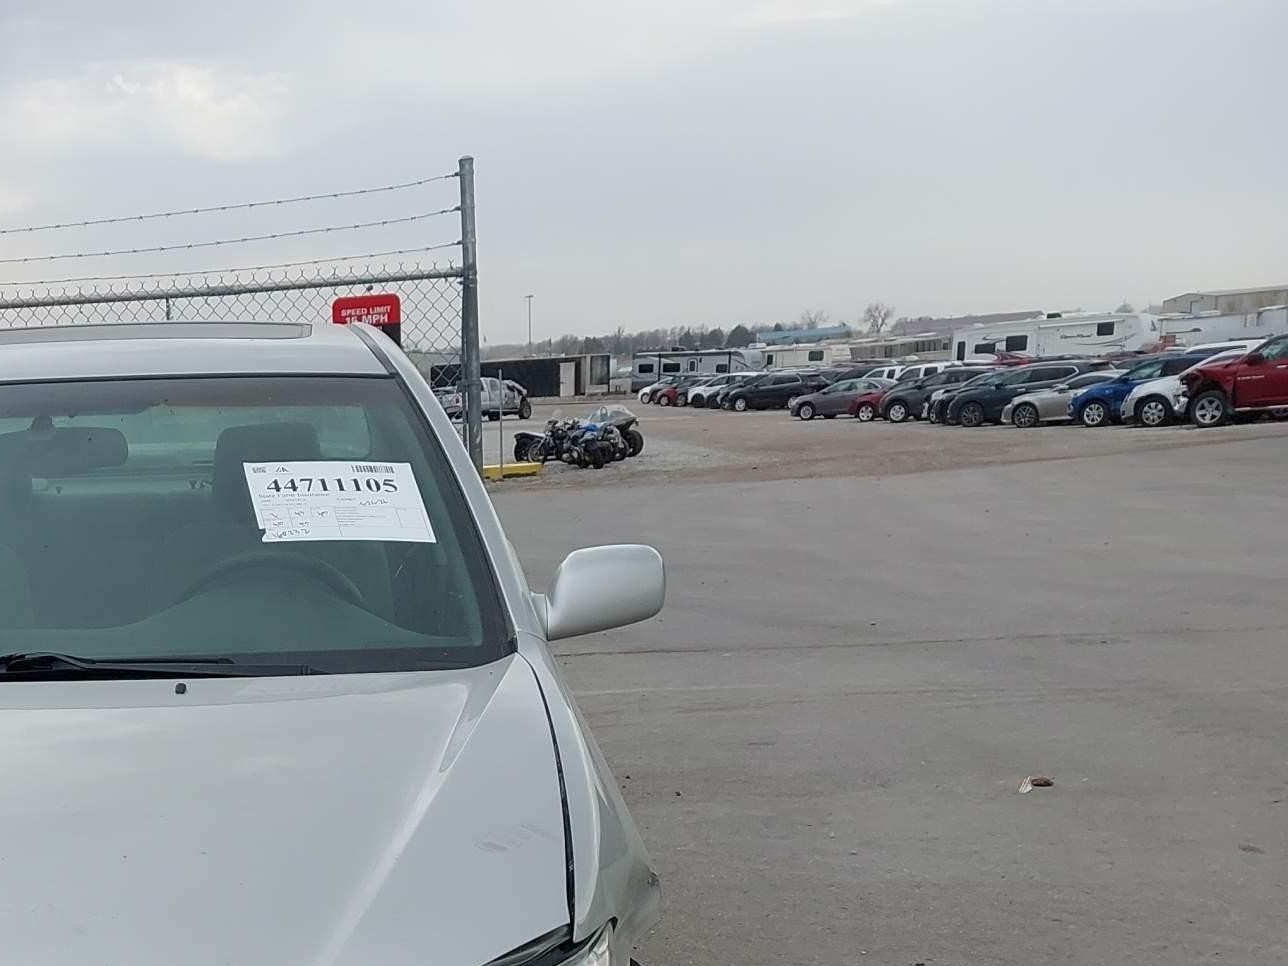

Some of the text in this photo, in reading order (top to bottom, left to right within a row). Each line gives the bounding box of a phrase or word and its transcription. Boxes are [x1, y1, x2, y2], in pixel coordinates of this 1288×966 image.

[341, 305, 391, 317] SPEED LIMIT
[362, 313, 388, 324] MPH
[267, 478, 398, 493] 44711105
